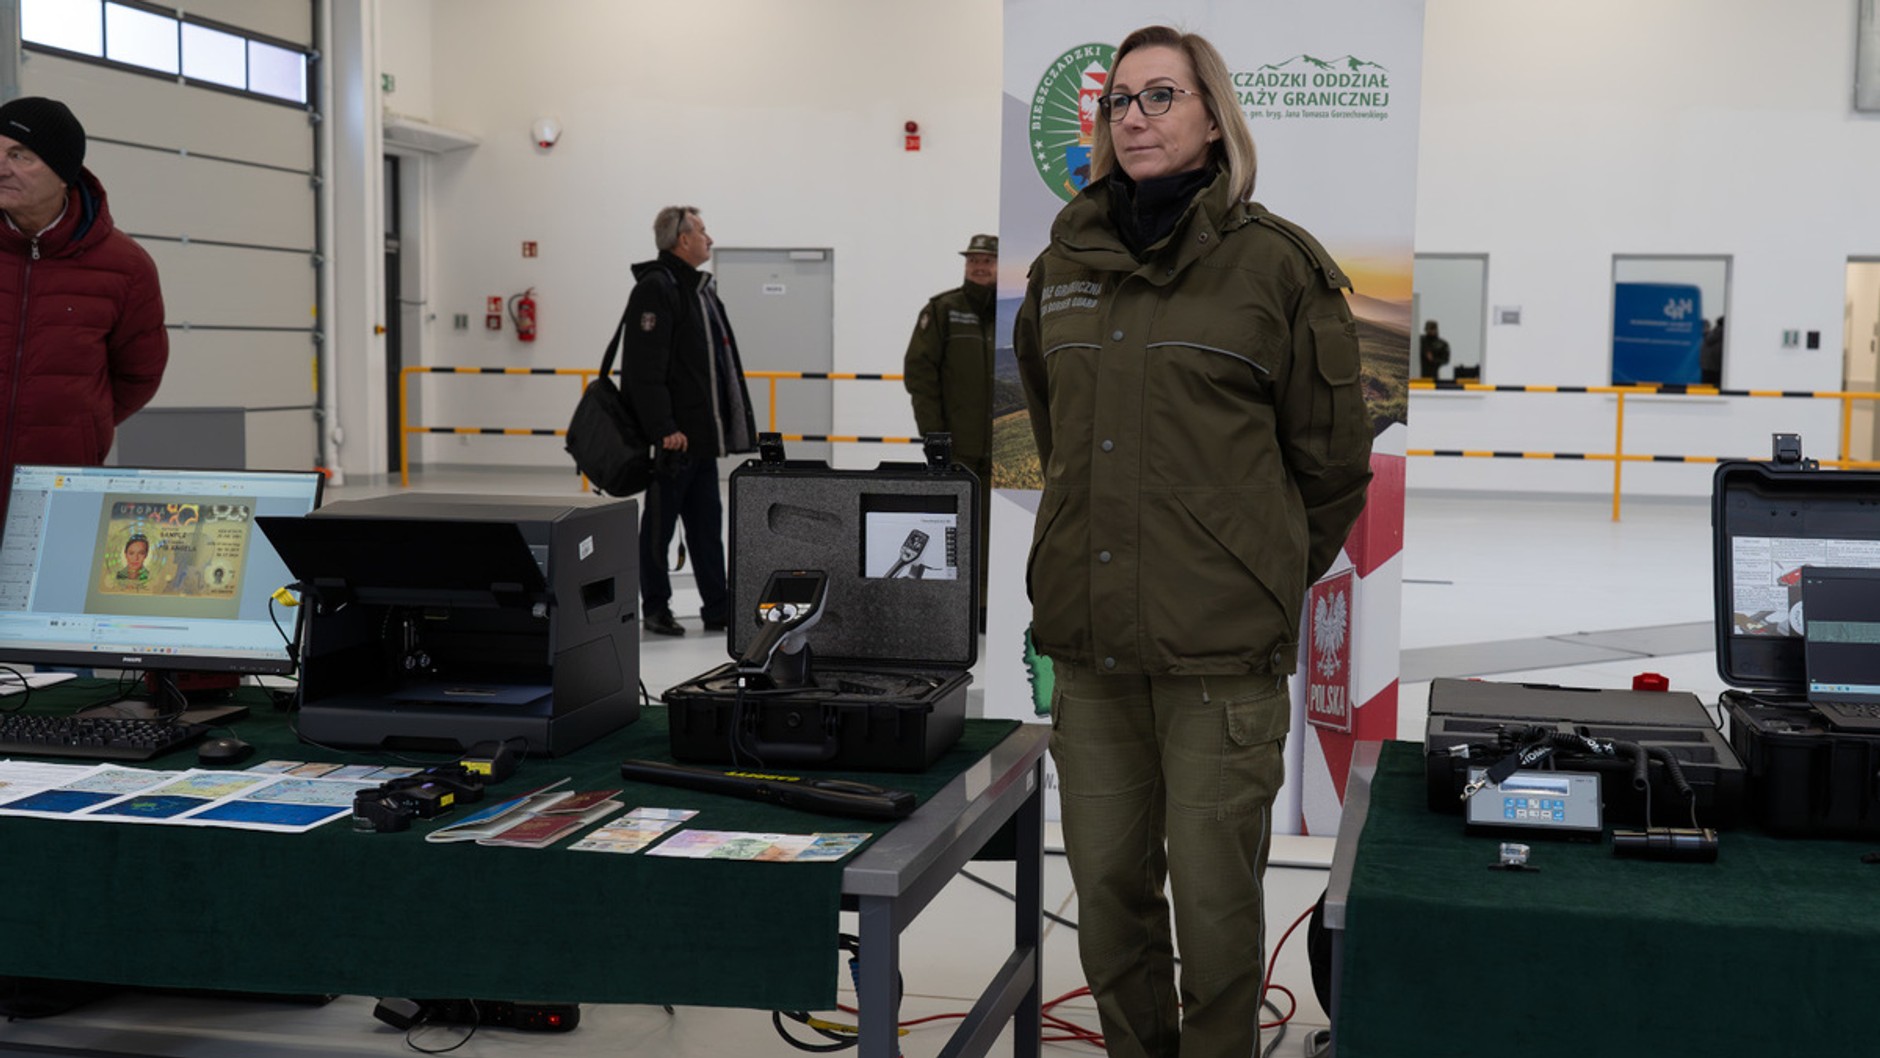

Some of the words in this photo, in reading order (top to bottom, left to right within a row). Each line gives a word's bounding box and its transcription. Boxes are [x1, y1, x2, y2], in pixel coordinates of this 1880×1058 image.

[1031, 46, 1101, 130] BIESZCZADZKI
[1230, 72, 1307, 88] CZADZKI
[1312, 72, 1390, 88] ODDZIAŁ
[1236, 88, 1278, 106] RAŻY
[1283, 91, 1390, 107] GRANICZNEJ
[1249, 110, 1264, 119] gen.
[1266, 109, 1281, 120] bryg.
[1285, 109, 1301, 118] Jana
[1302, 109, 1329, 118] Tomasza
[1330, 109, 1389, 121] Gorzechowskiego
[1310, 684, 1344, 717] POLSKA
